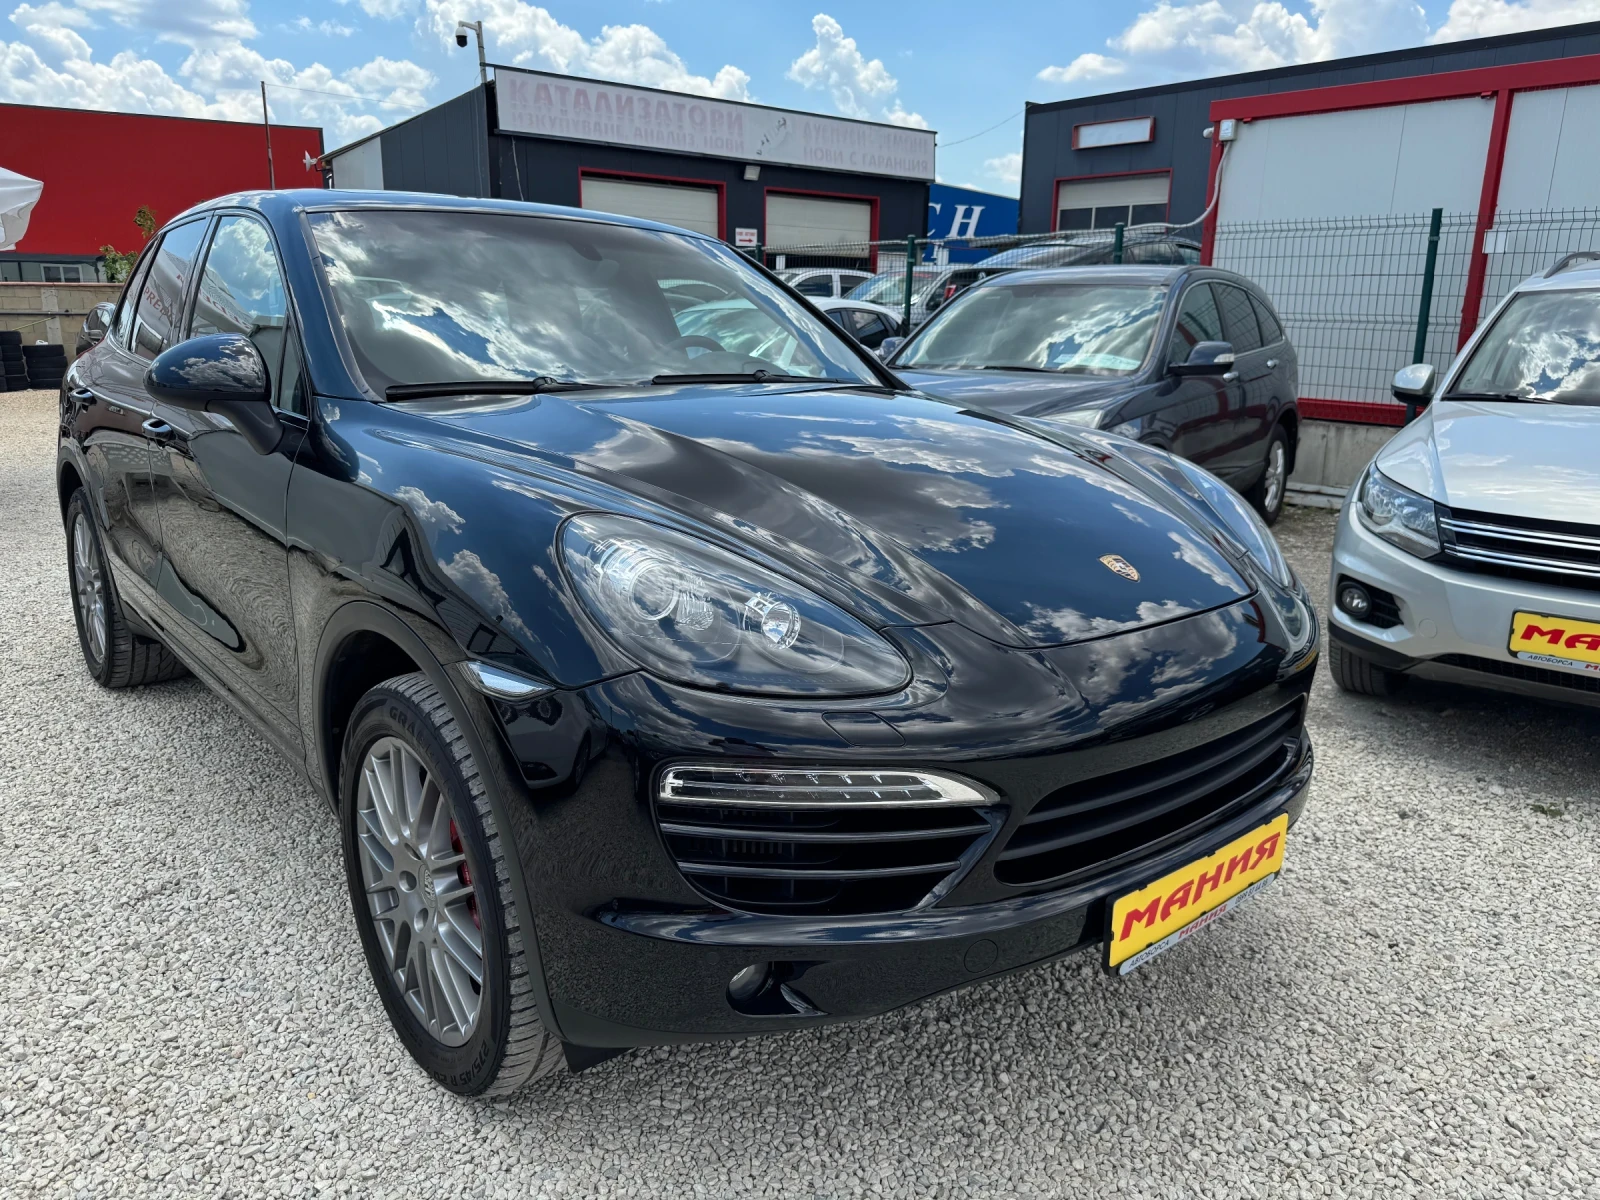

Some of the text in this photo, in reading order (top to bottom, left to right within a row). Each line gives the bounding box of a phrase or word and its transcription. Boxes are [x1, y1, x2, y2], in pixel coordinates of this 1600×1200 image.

[508, 78, 744, 137] КАТАЛИЗАТОРИ
[803, 146, 844, 165] НОВИ
[861, 152, 929, 174] ГАРАНЦИЯ
[1527, 654, 1573, 666] АВТОБОРСА
[1119, 831, 1281, 942] МАНИЯ
[1128, 939, 1170, 969] АВТОБОРСА
[1177, 904, 1228, 940] МАНИЯ
